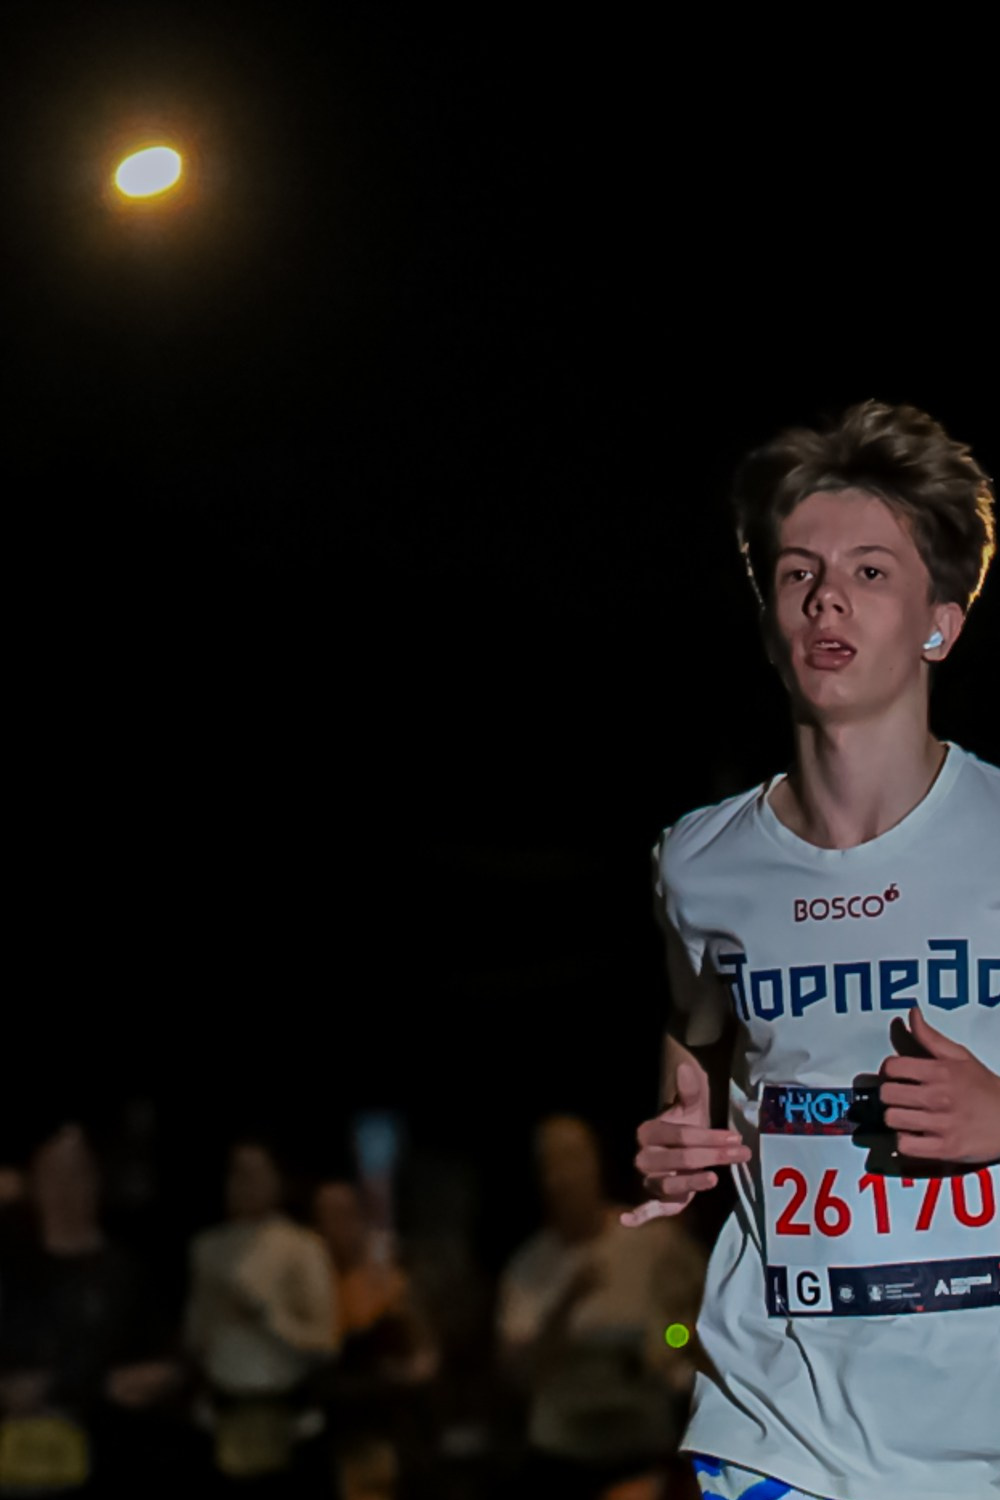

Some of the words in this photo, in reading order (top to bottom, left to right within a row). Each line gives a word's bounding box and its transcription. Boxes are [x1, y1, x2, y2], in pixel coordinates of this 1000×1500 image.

[794, 896, 885, 922] BOSCO
[773, 1166, 996, 1238] 26170
[796, 1271, 821, 1306] G
